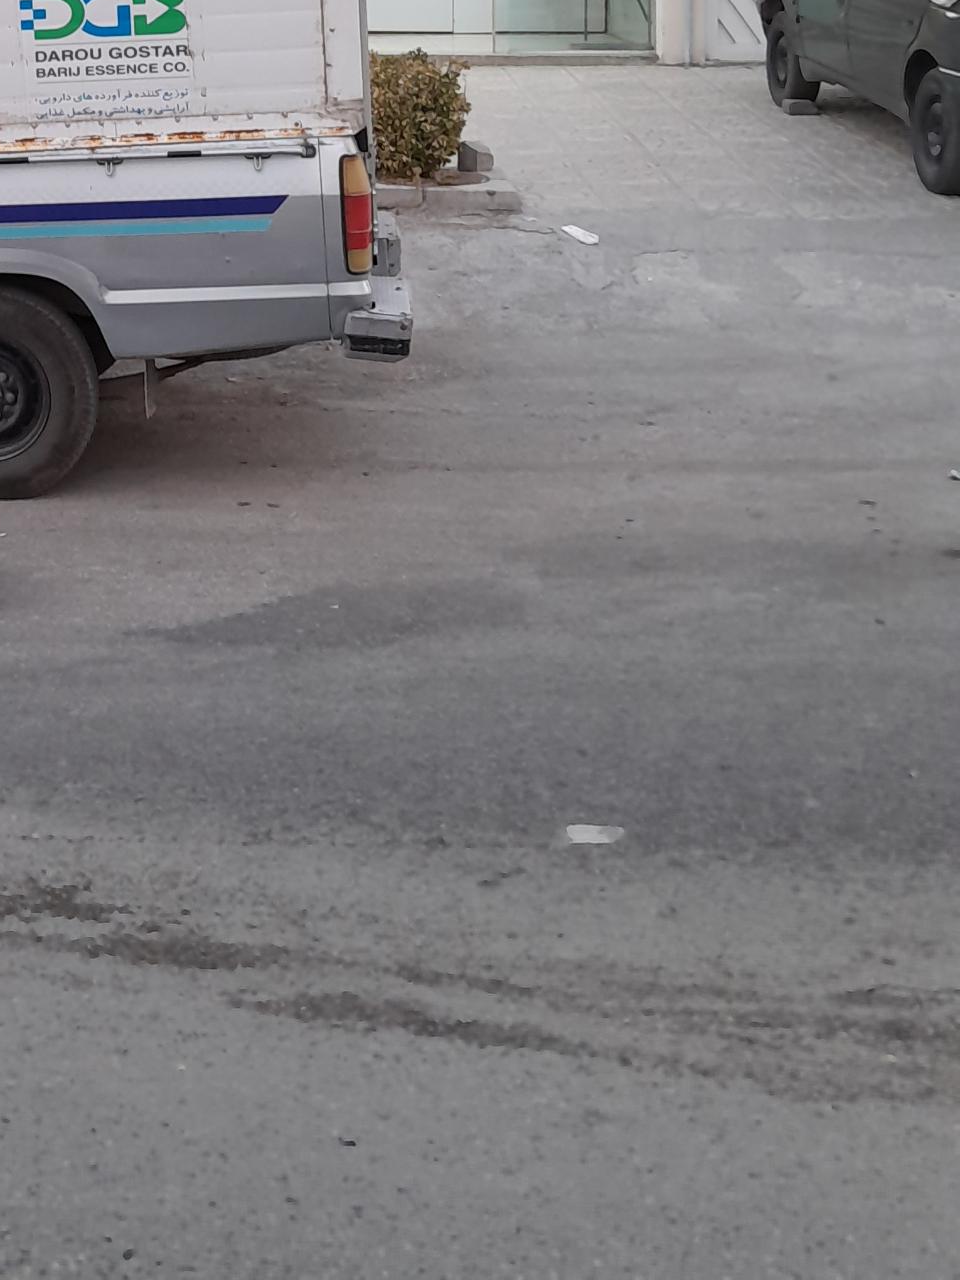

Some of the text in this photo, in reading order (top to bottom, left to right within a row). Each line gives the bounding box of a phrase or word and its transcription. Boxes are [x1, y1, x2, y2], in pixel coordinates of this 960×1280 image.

[35, 44, 190, 63] DAROU GOSTAR
[36, 61, 190, 78] BARIJ ESSENCE CO.
[73, 92, 93, 102] های
[134, 89, 161, 98] کننده
[162, 89, 189, 101] توزیع
[36, 108, 65, 120] غذایی
[67, 106, 98, 119] مکمل
[106, 105, 145, 118] بهداشتی
[154, 102, 189, 115] آرایشی
